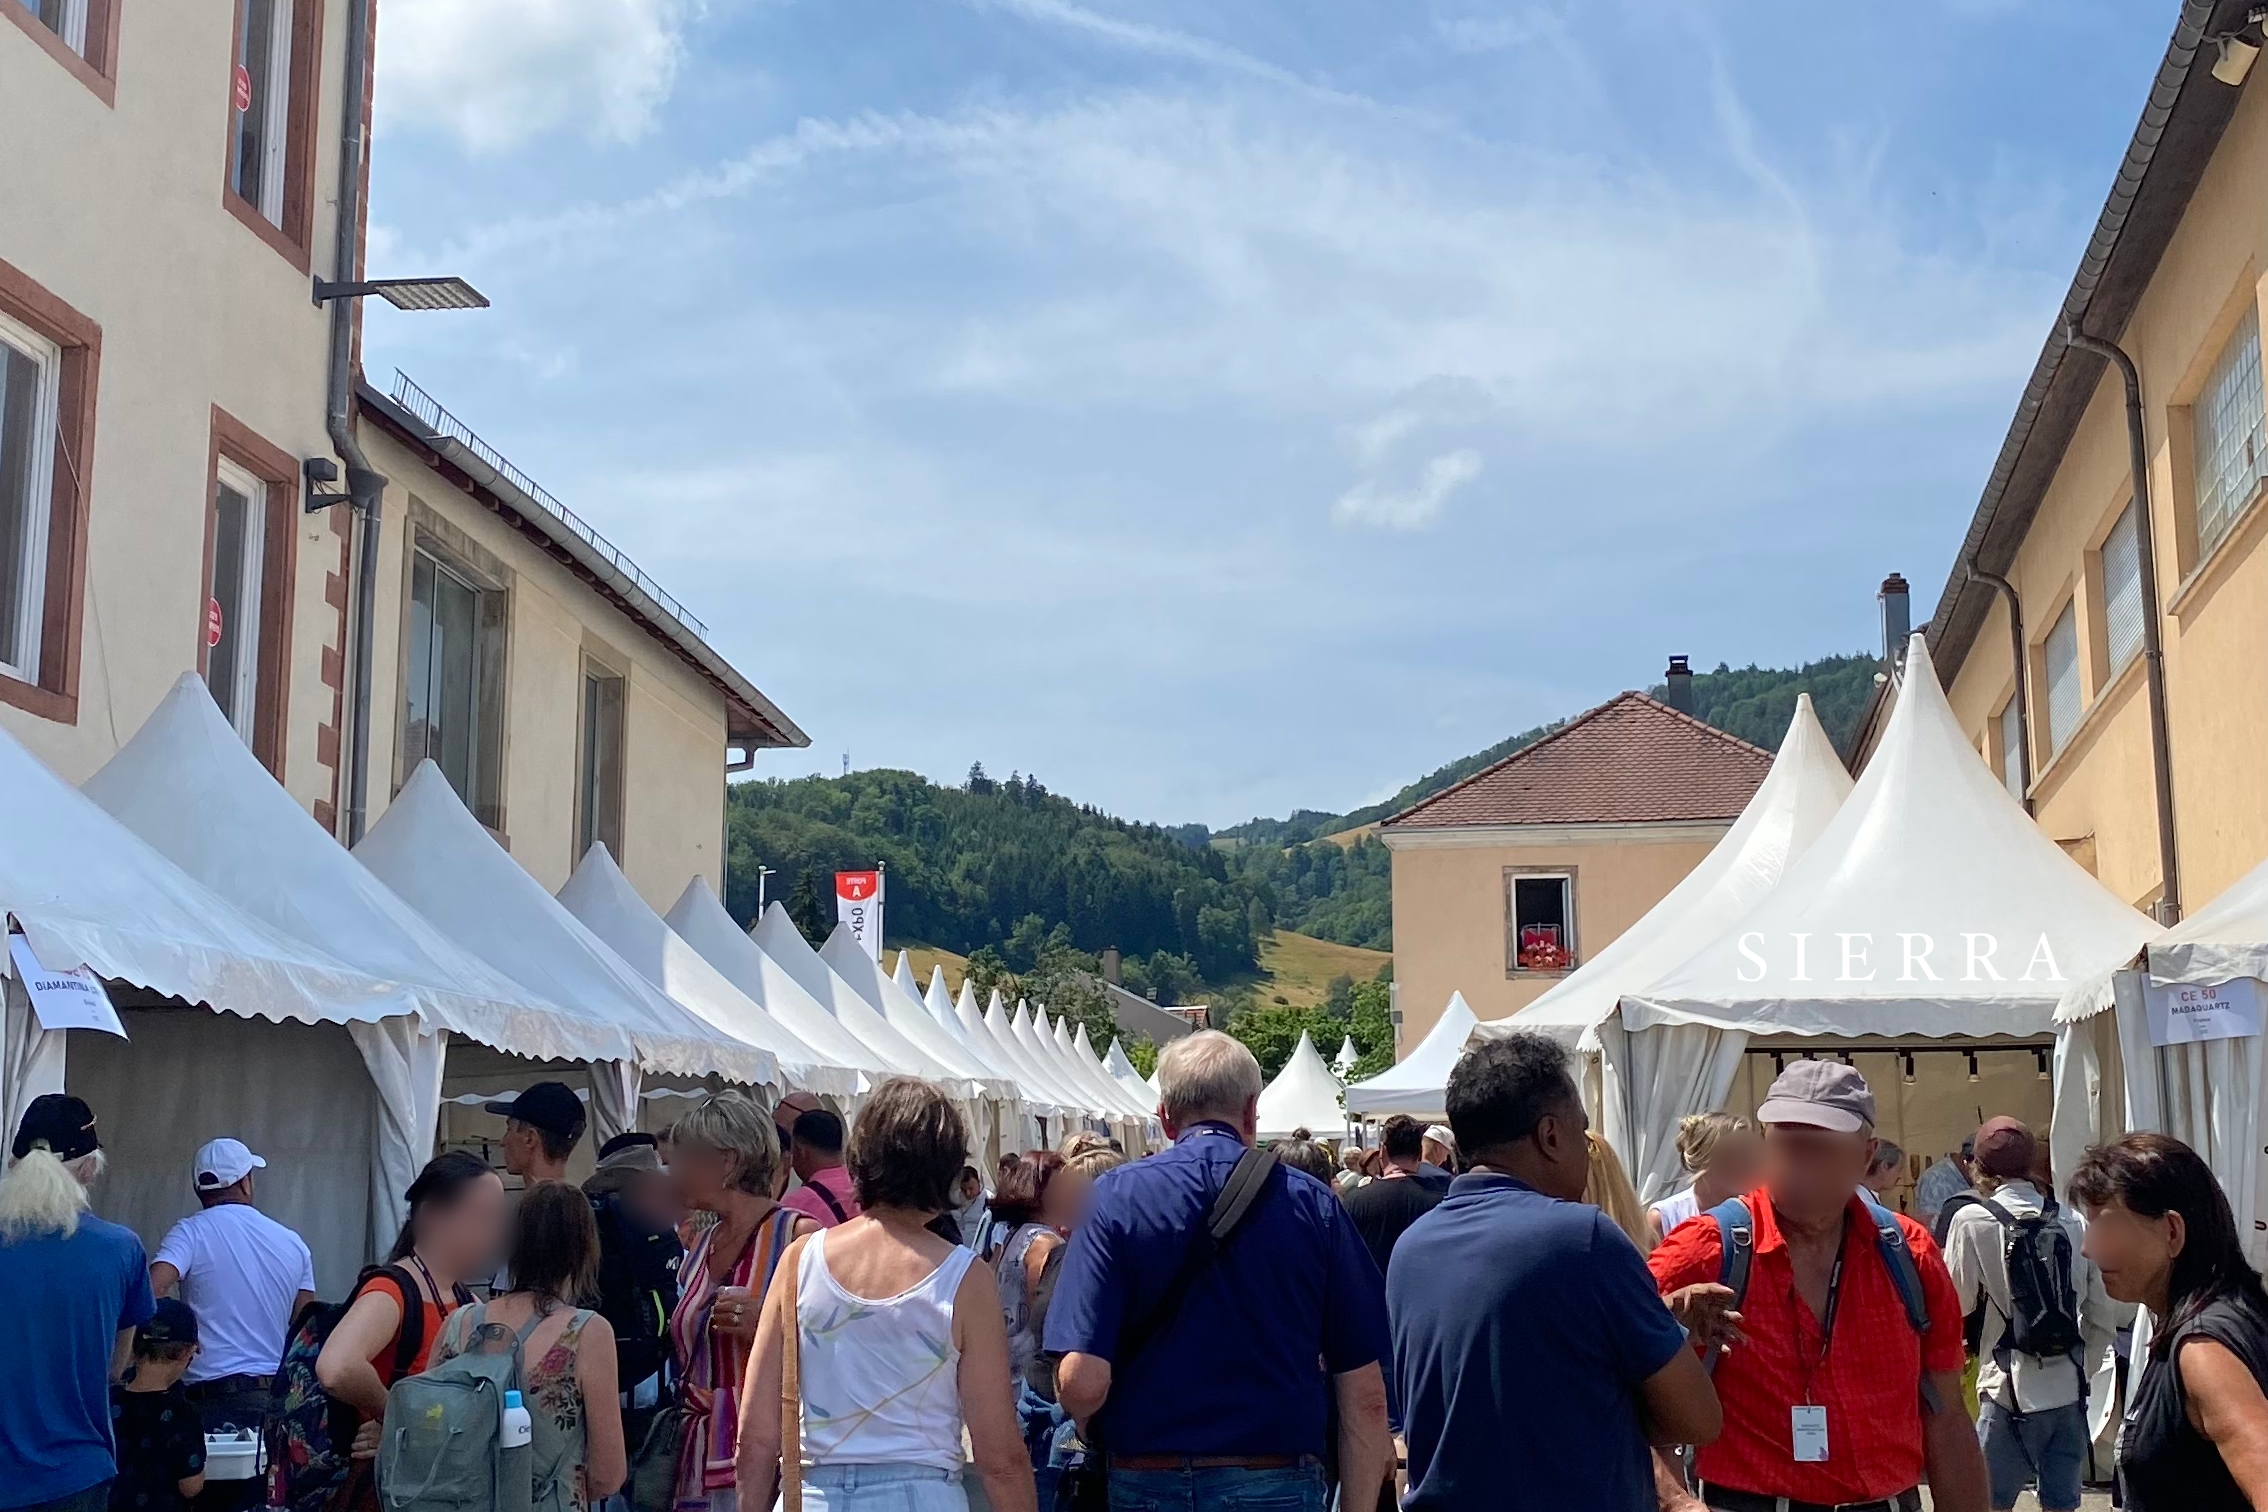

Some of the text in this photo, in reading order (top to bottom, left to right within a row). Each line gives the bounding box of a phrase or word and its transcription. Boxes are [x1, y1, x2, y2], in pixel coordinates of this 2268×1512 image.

[2181, 989, 2217, 1002] CE 50
[2171, 1001, 2231, 1015] MADAQUARTZ
